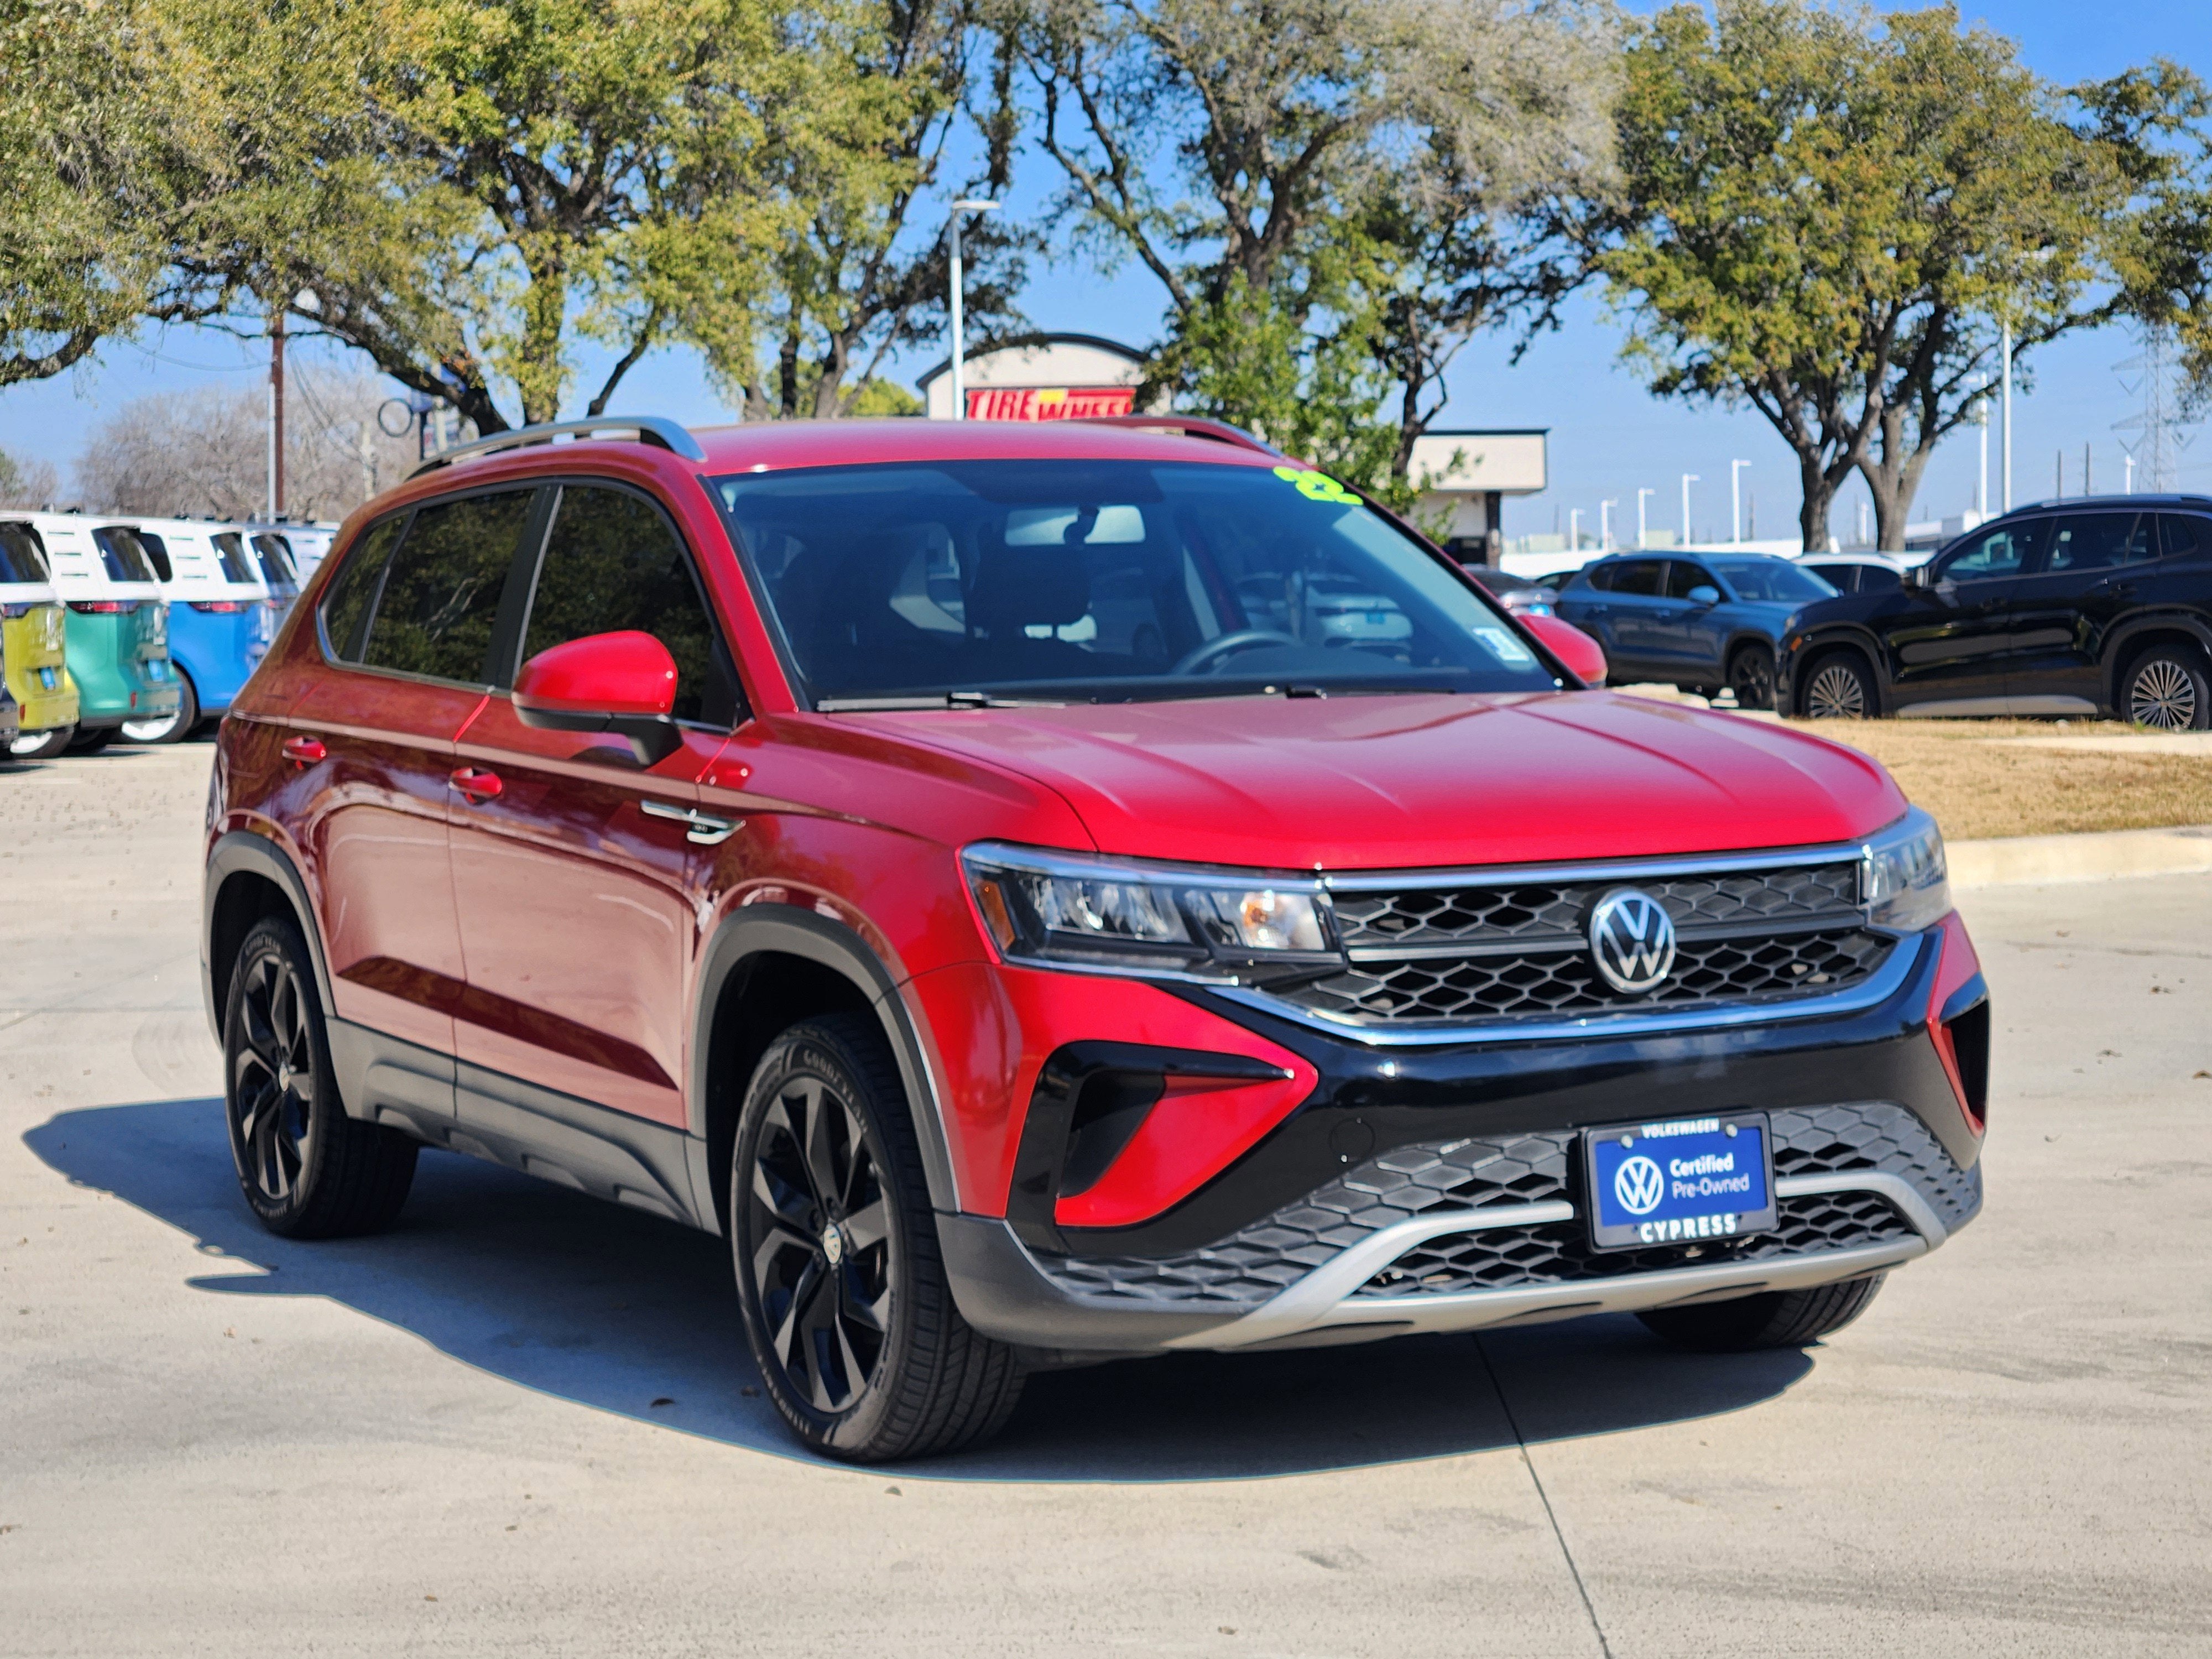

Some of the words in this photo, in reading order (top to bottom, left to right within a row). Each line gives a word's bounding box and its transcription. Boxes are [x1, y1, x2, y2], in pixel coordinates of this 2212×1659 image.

[967, 388, 1037, 421] TIRE
[1641, 1118, 1719, 1138] VOLKSWAGEN
[1670, 1152, 1734, 1177] Certified
[1672, 1173, 1750, 1199] Pre-Owned
[1640, 1214, 1736, 1243] CYPRESS
